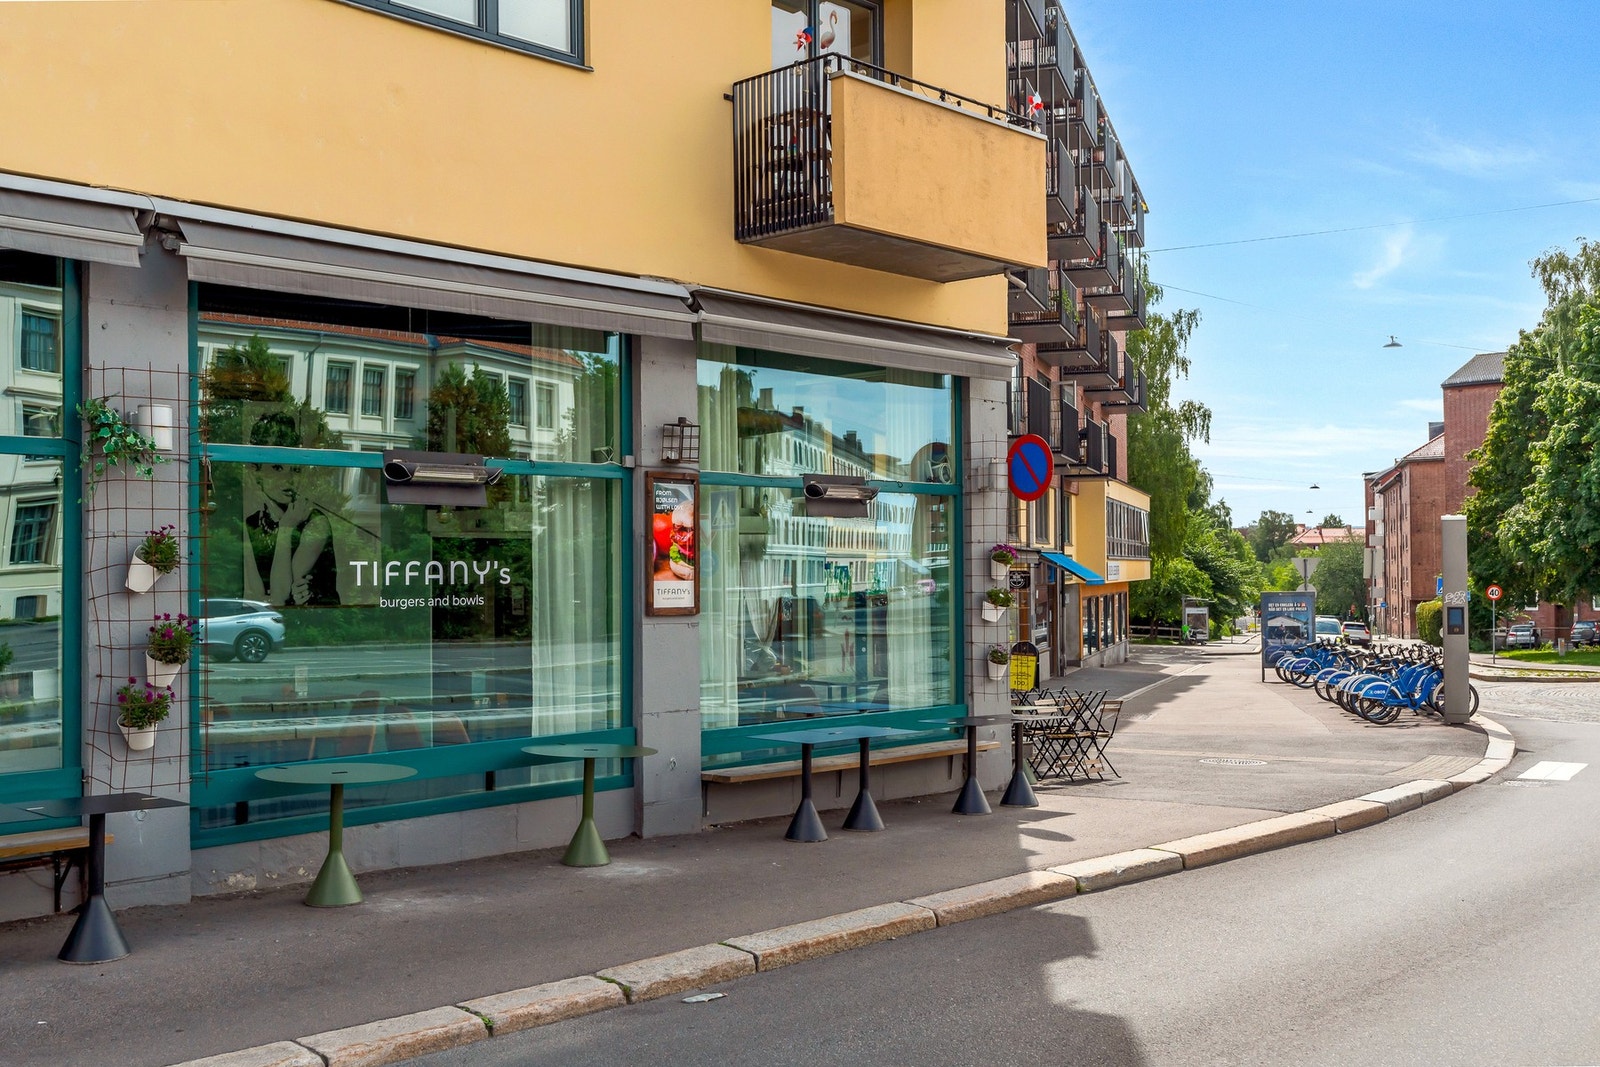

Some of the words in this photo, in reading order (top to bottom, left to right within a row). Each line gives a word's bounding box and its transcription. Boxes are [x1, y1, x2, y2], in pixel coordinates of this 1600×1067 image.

[349, 560, 511, 586] TIFFANY's
[1489, 588, 1499, 596] 40
[379, 597, 426, 610] burgers
[427, 595, 450, 607] and
[452, 594, 485, 606] bowls
